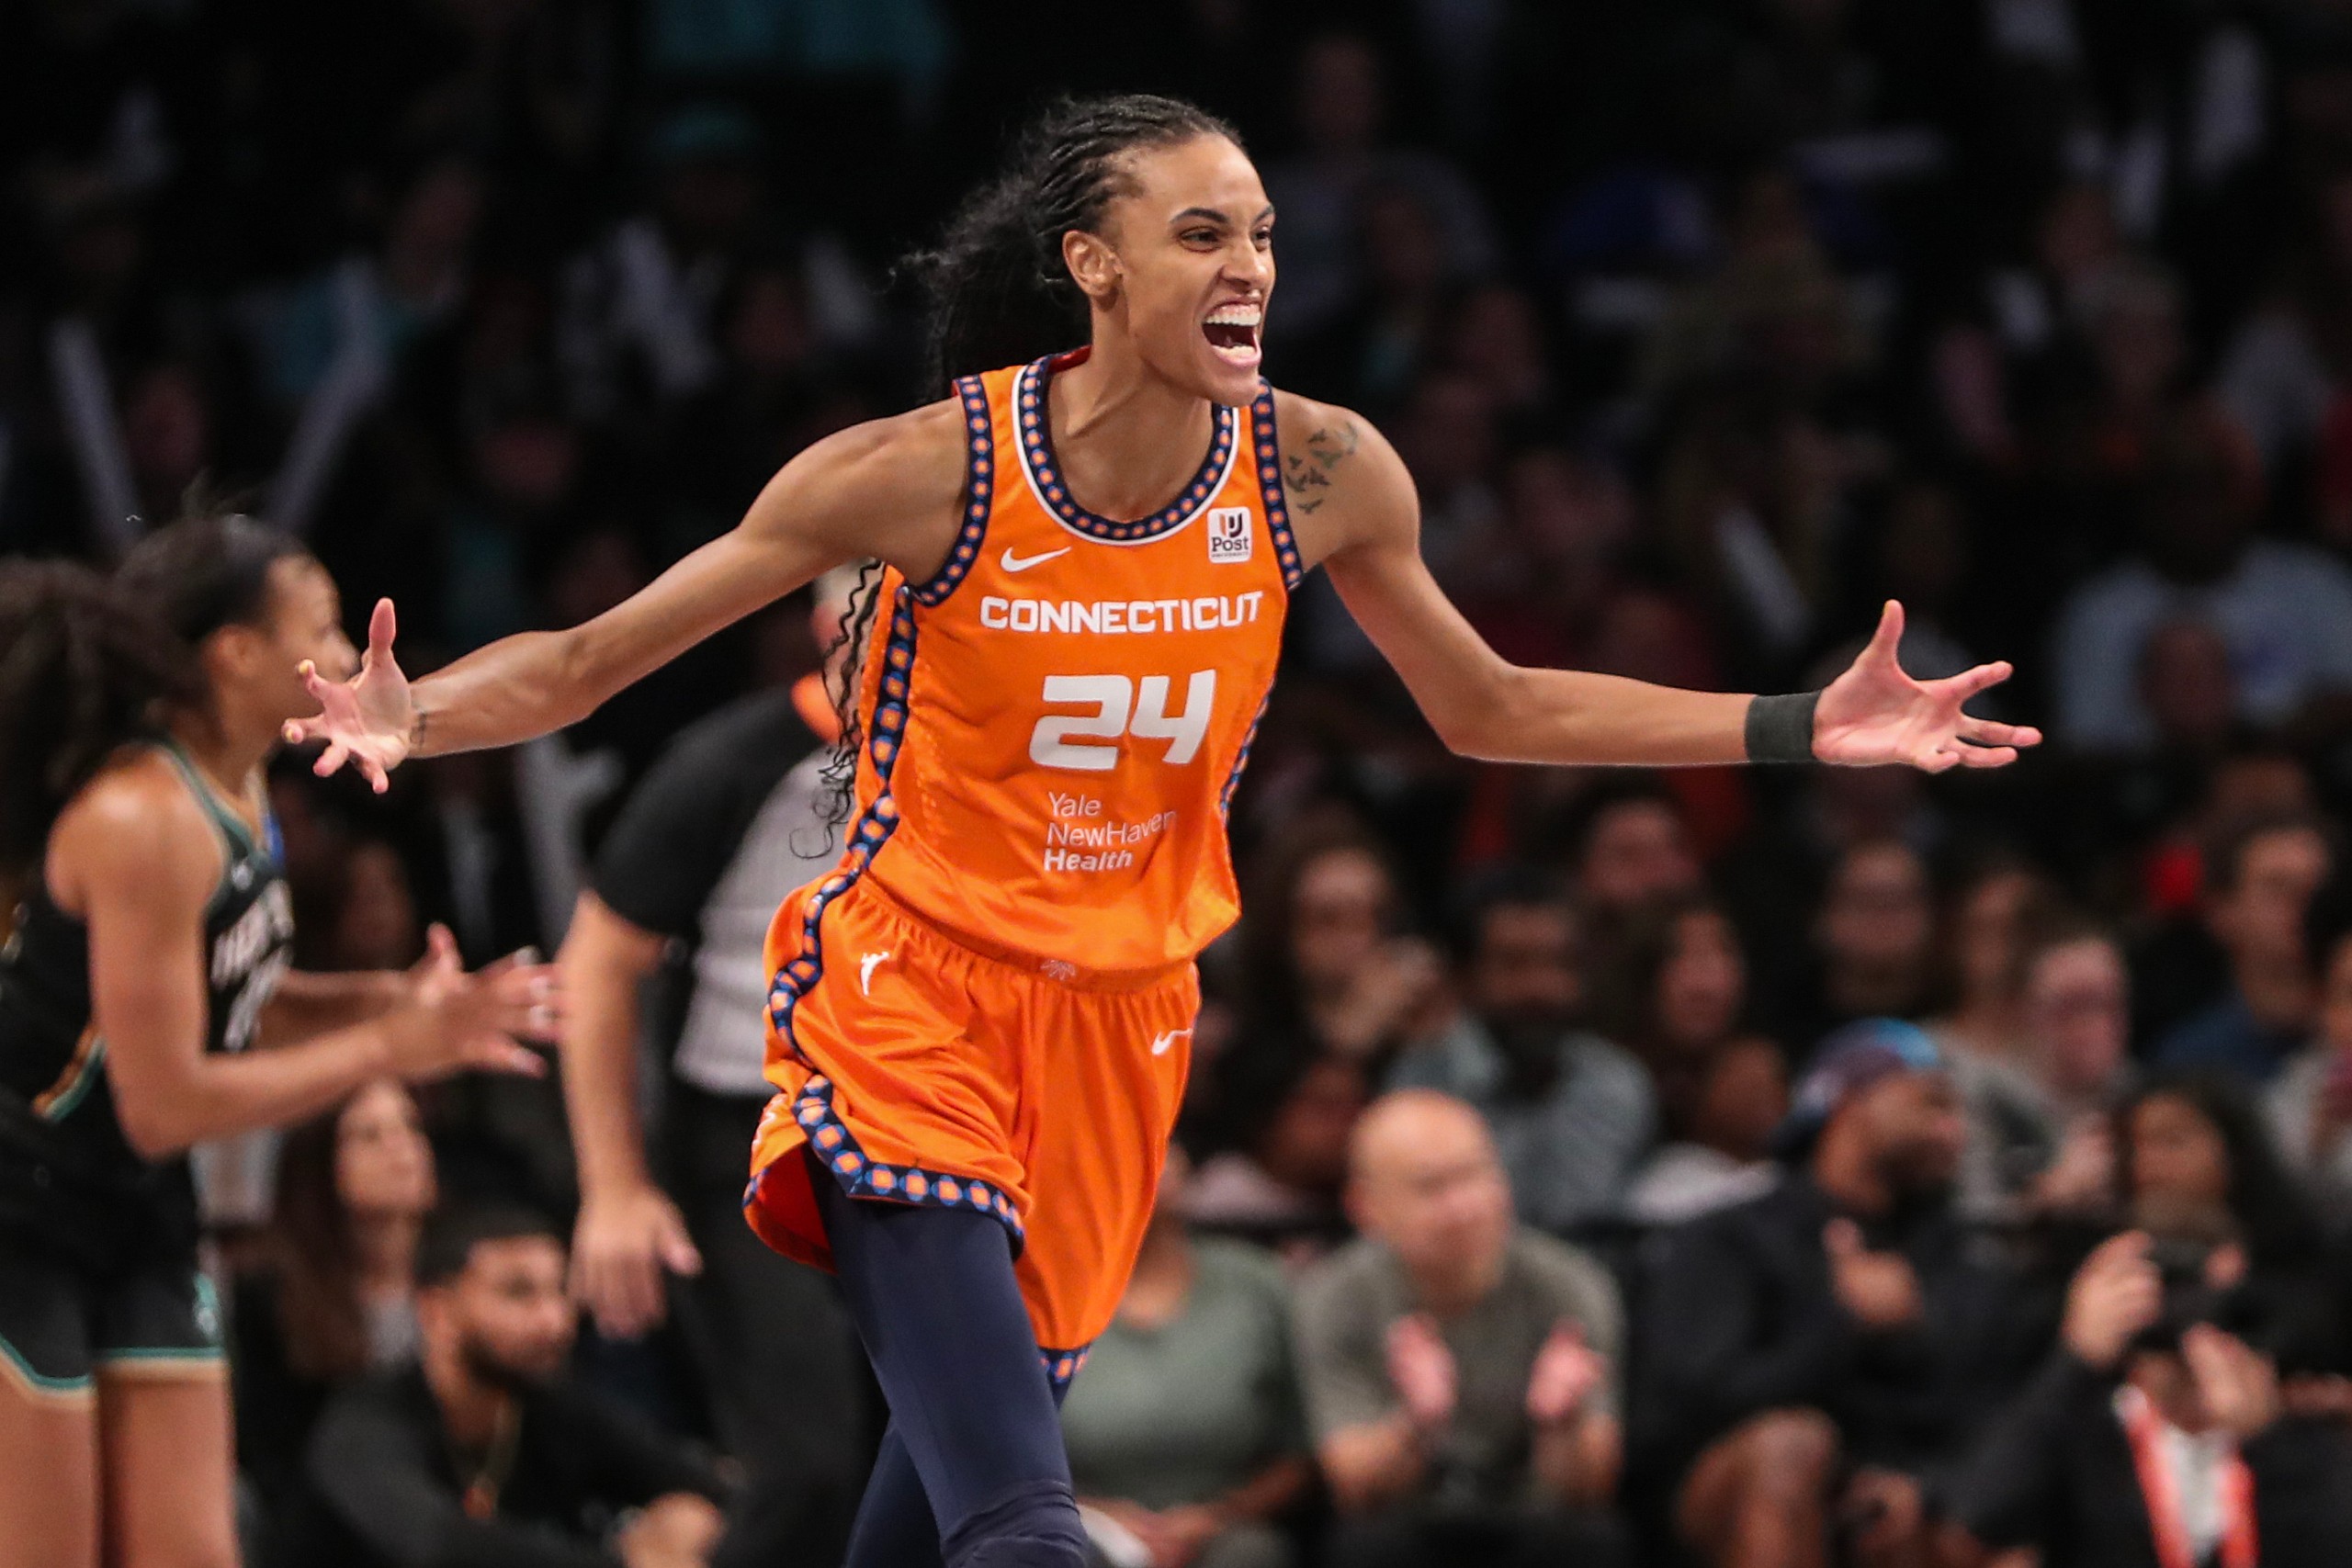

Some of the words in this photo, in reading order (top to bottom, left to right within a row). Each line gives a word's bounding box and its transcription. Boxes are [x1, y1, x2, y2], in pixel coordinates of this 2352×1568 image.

[1212, 536, 1249, 552] Post
[980, 591, 1263, 633] CONNECTICUT
[1029, 669, 1216, 770] 24
[1048, 791, 1102, 817] Yale
[1044, 848, 1133, 872] Health
